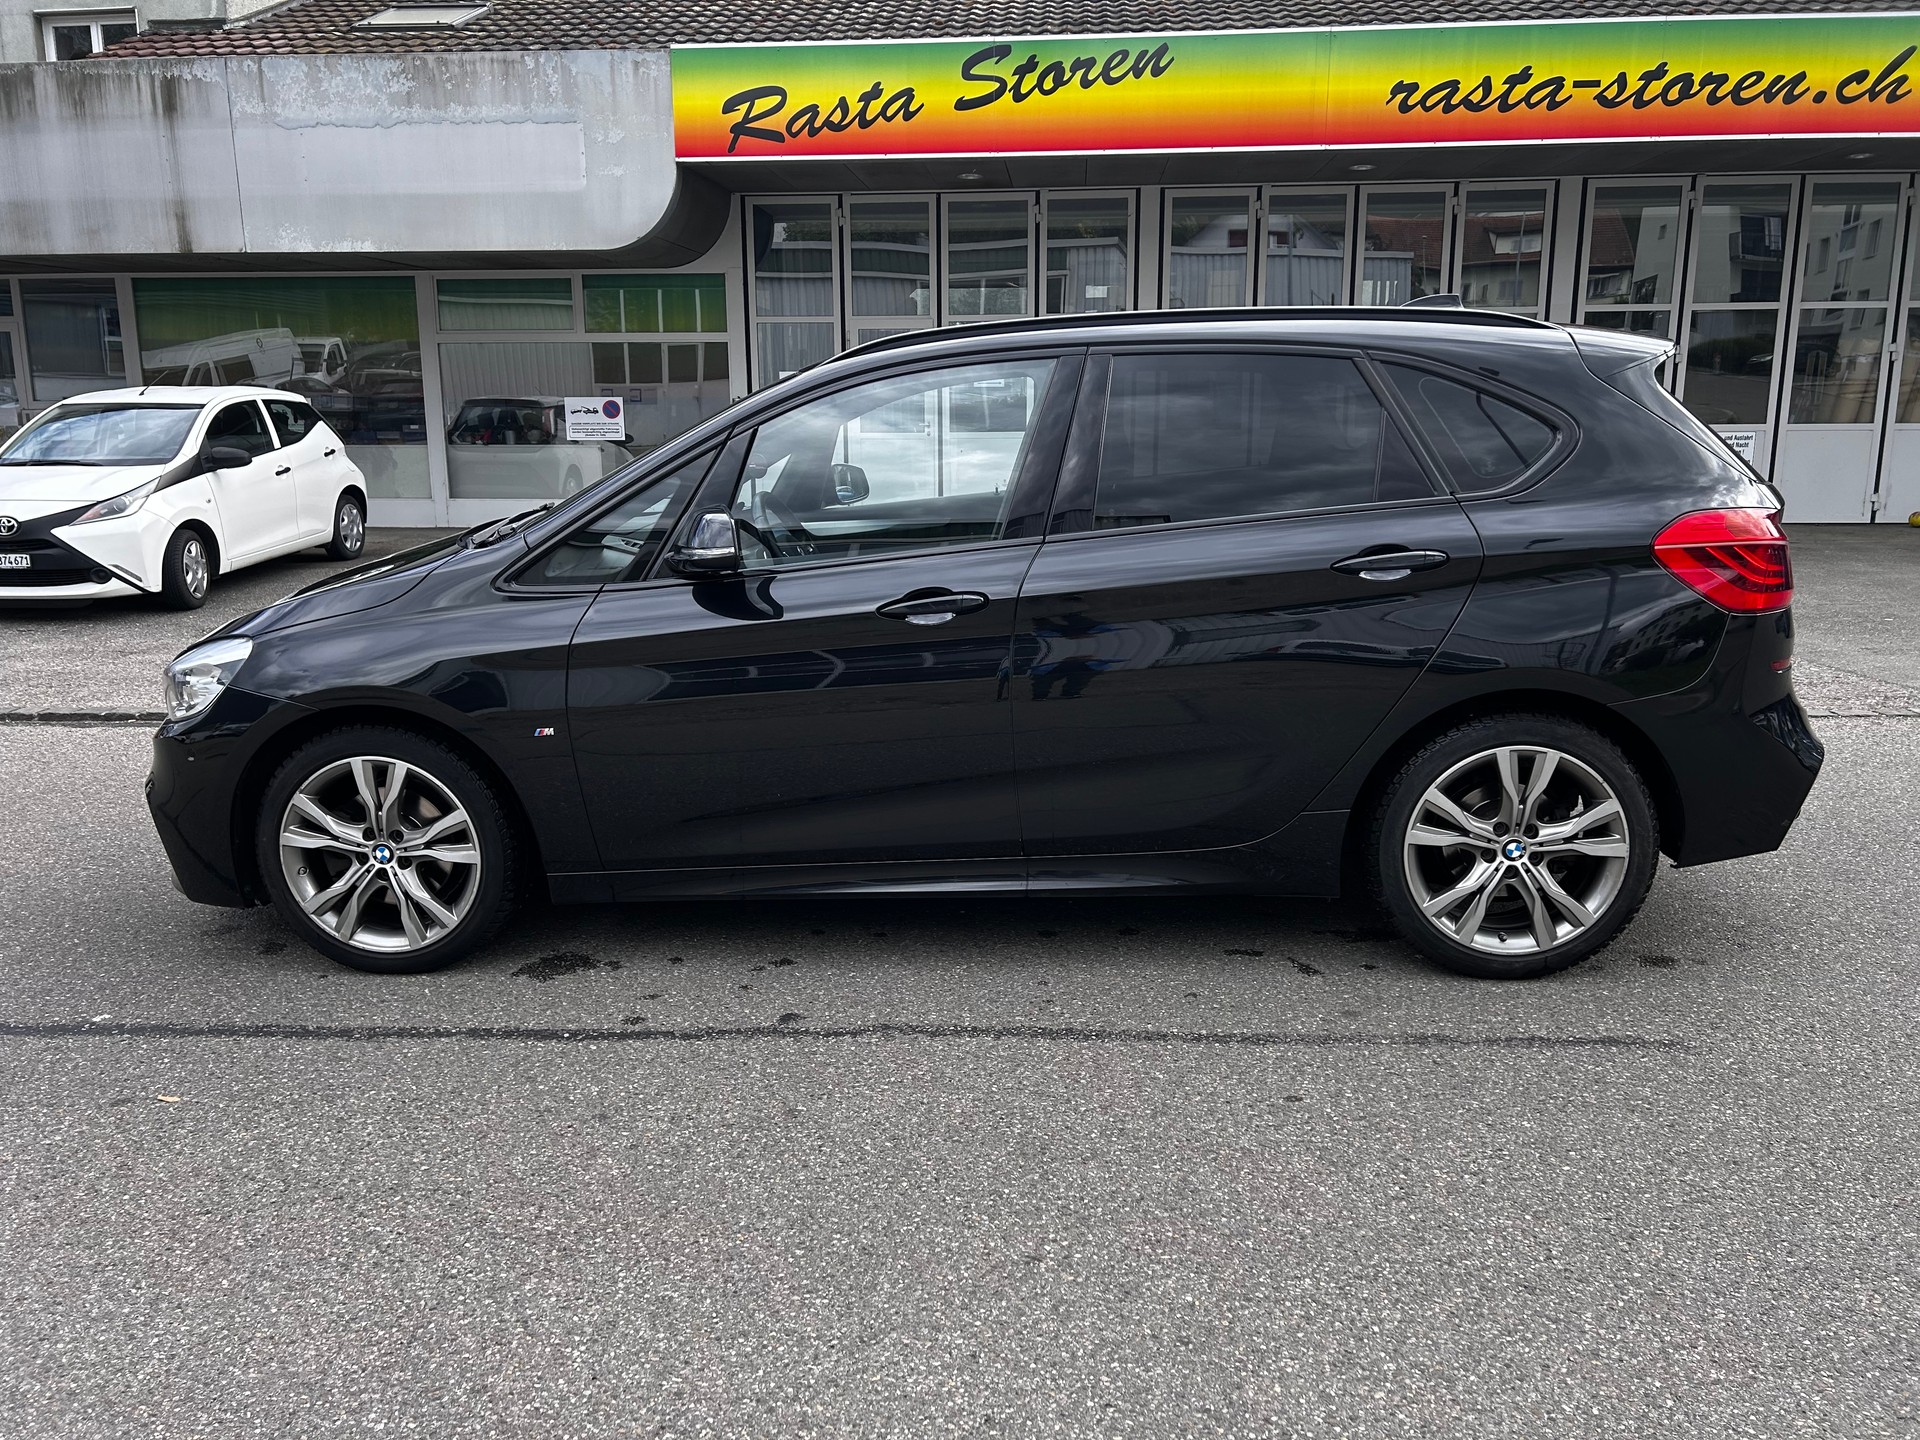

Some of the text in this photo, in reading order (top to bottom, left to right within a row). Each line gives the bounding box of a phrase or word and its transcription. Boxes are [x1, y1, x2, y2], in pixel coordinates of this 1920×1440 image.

[721, 42, 1175, 153] Rasta Storen
[1386, 44, 1918, 115] rasta-storen.ch
